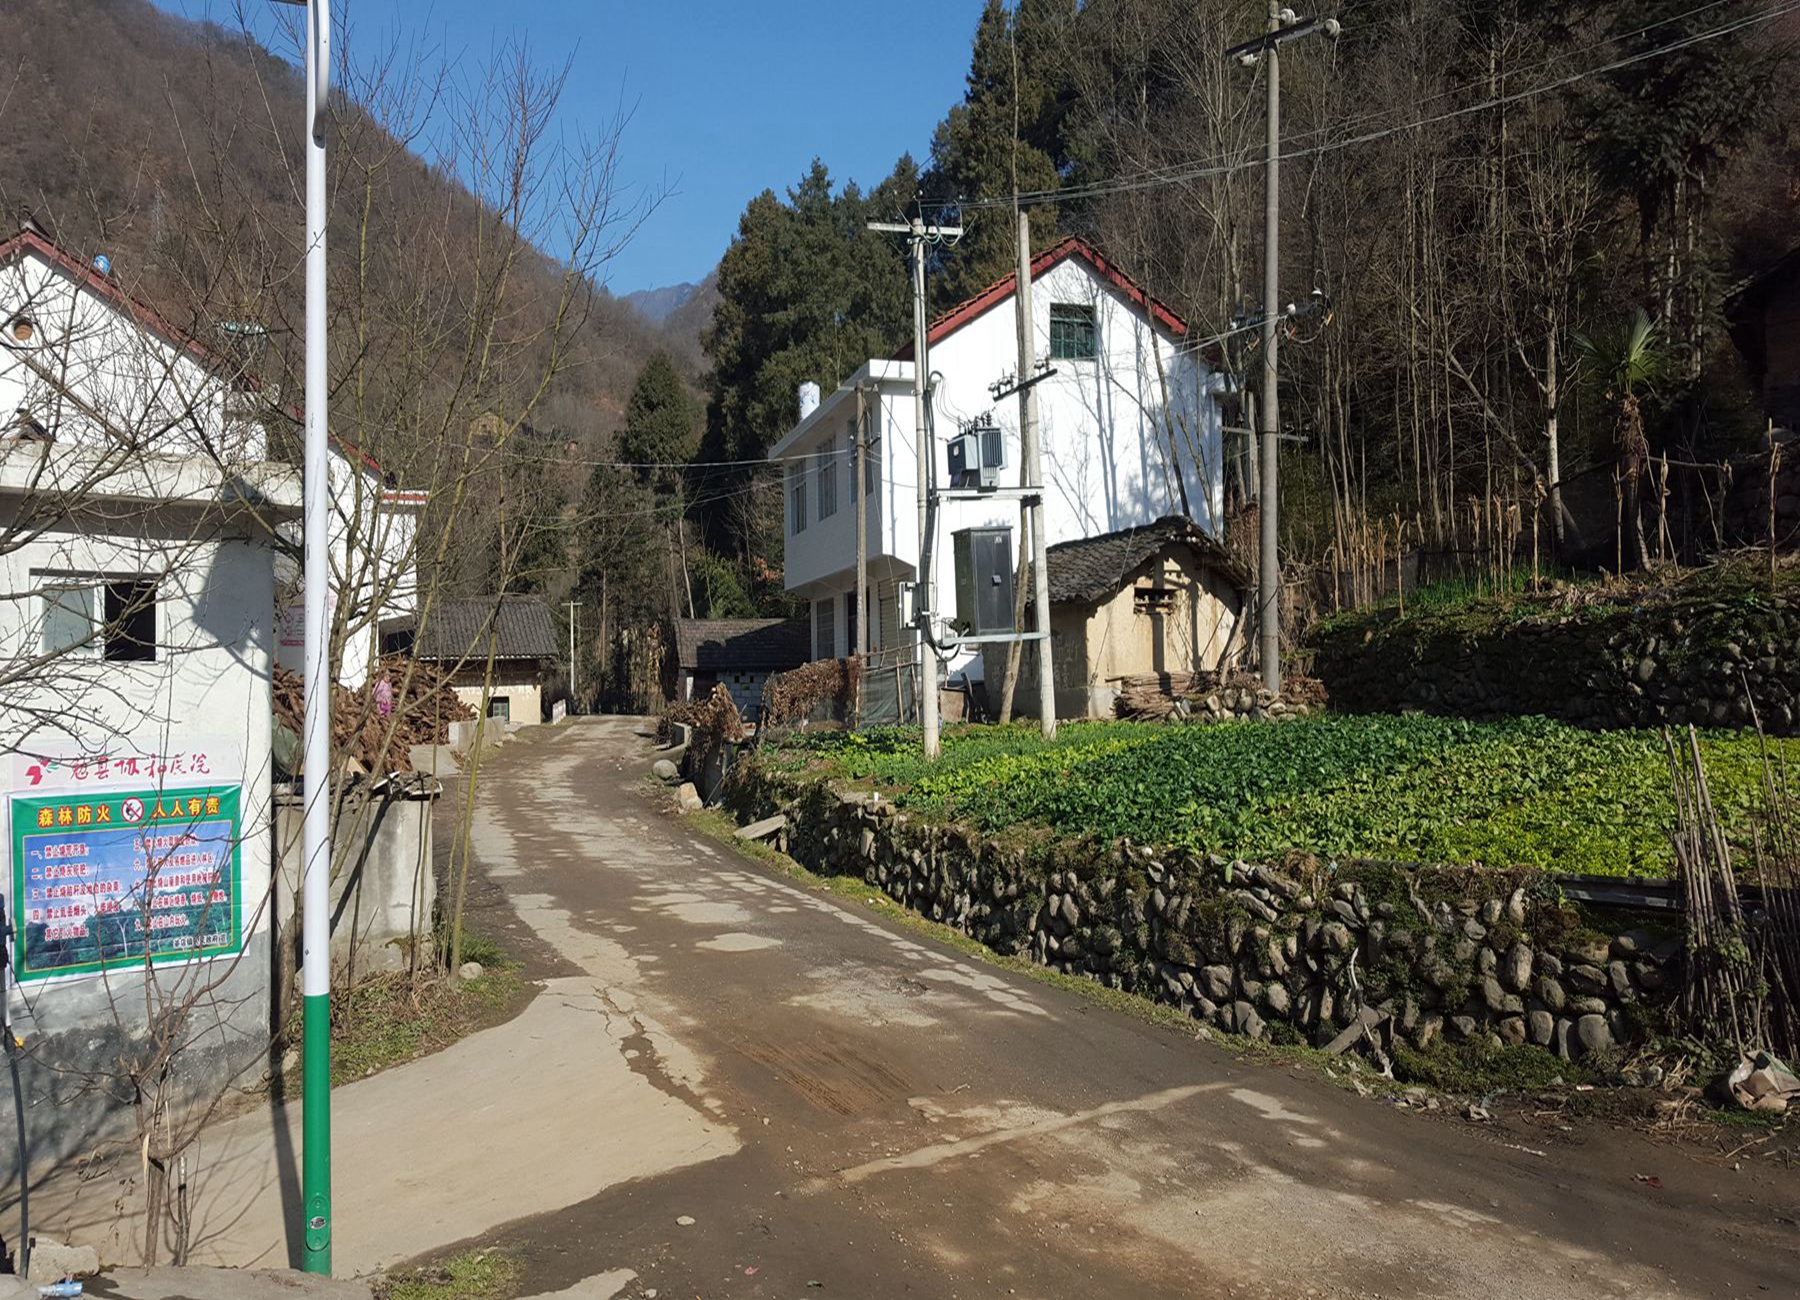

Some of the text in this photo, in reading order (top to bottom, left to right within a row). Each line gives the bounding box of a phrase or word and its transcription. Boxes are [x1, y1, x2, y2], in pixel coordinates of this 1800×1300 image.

[38, 796, 219, 828] 森林防火 人人有责
